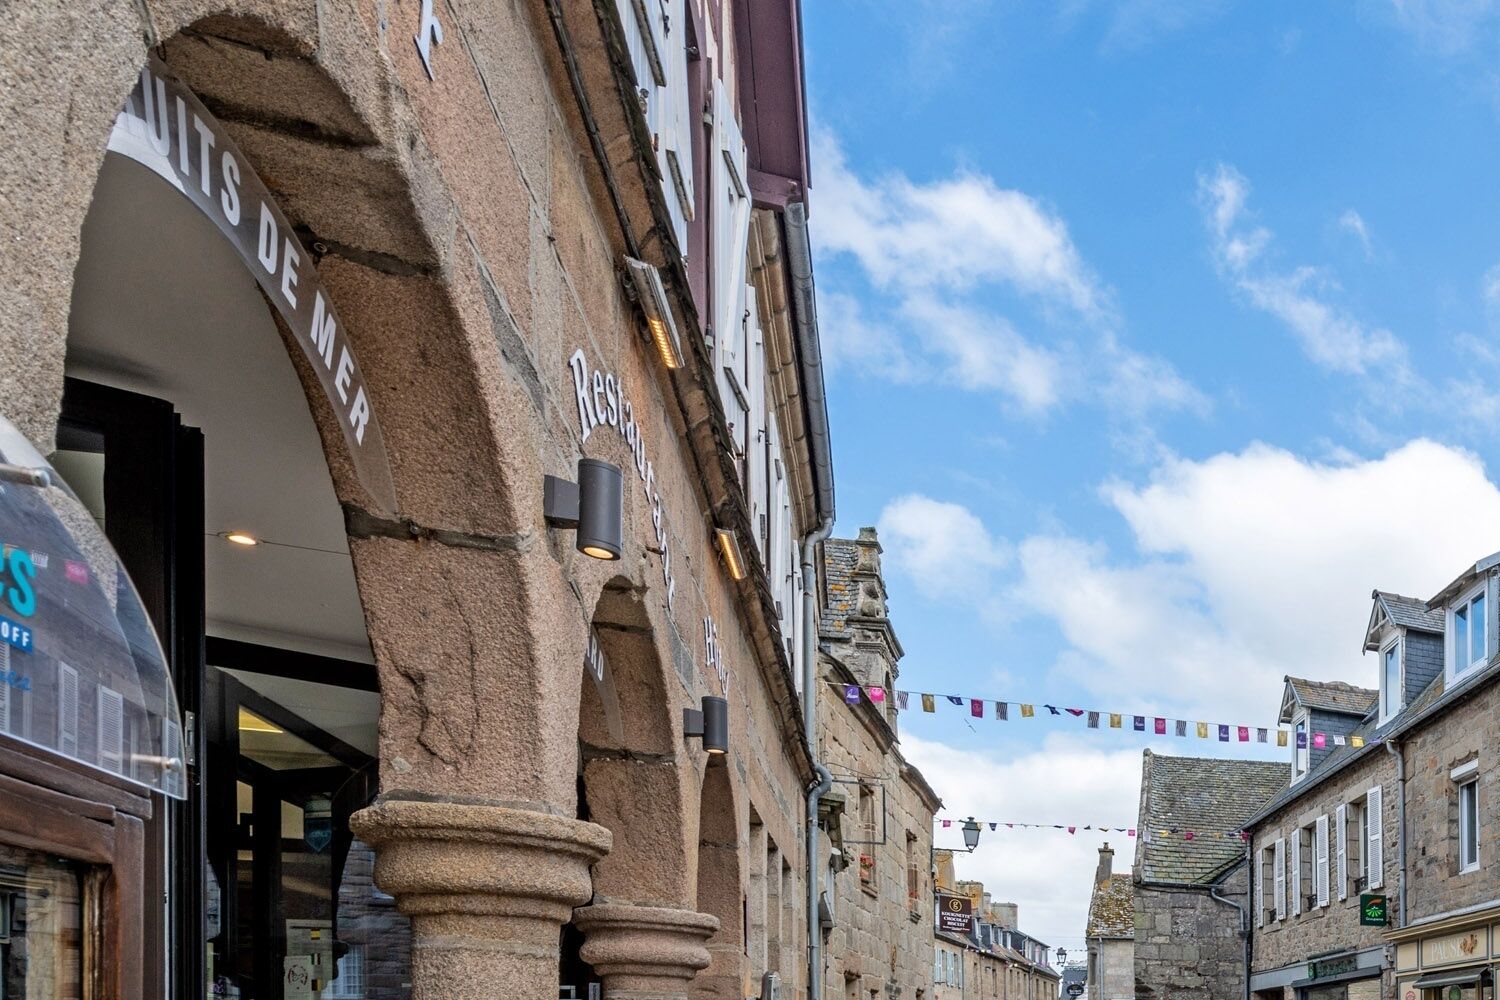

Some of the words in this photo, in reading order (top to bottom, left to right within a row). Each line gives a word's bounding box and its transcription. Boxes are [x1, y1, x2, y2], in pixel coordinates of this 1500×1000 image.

[126, 64, 242, 227] UITS
[257, 200, 300, 311] DE
[309, 290, 371, 447] MER
[569, 347, 676, 613] Restaurant
